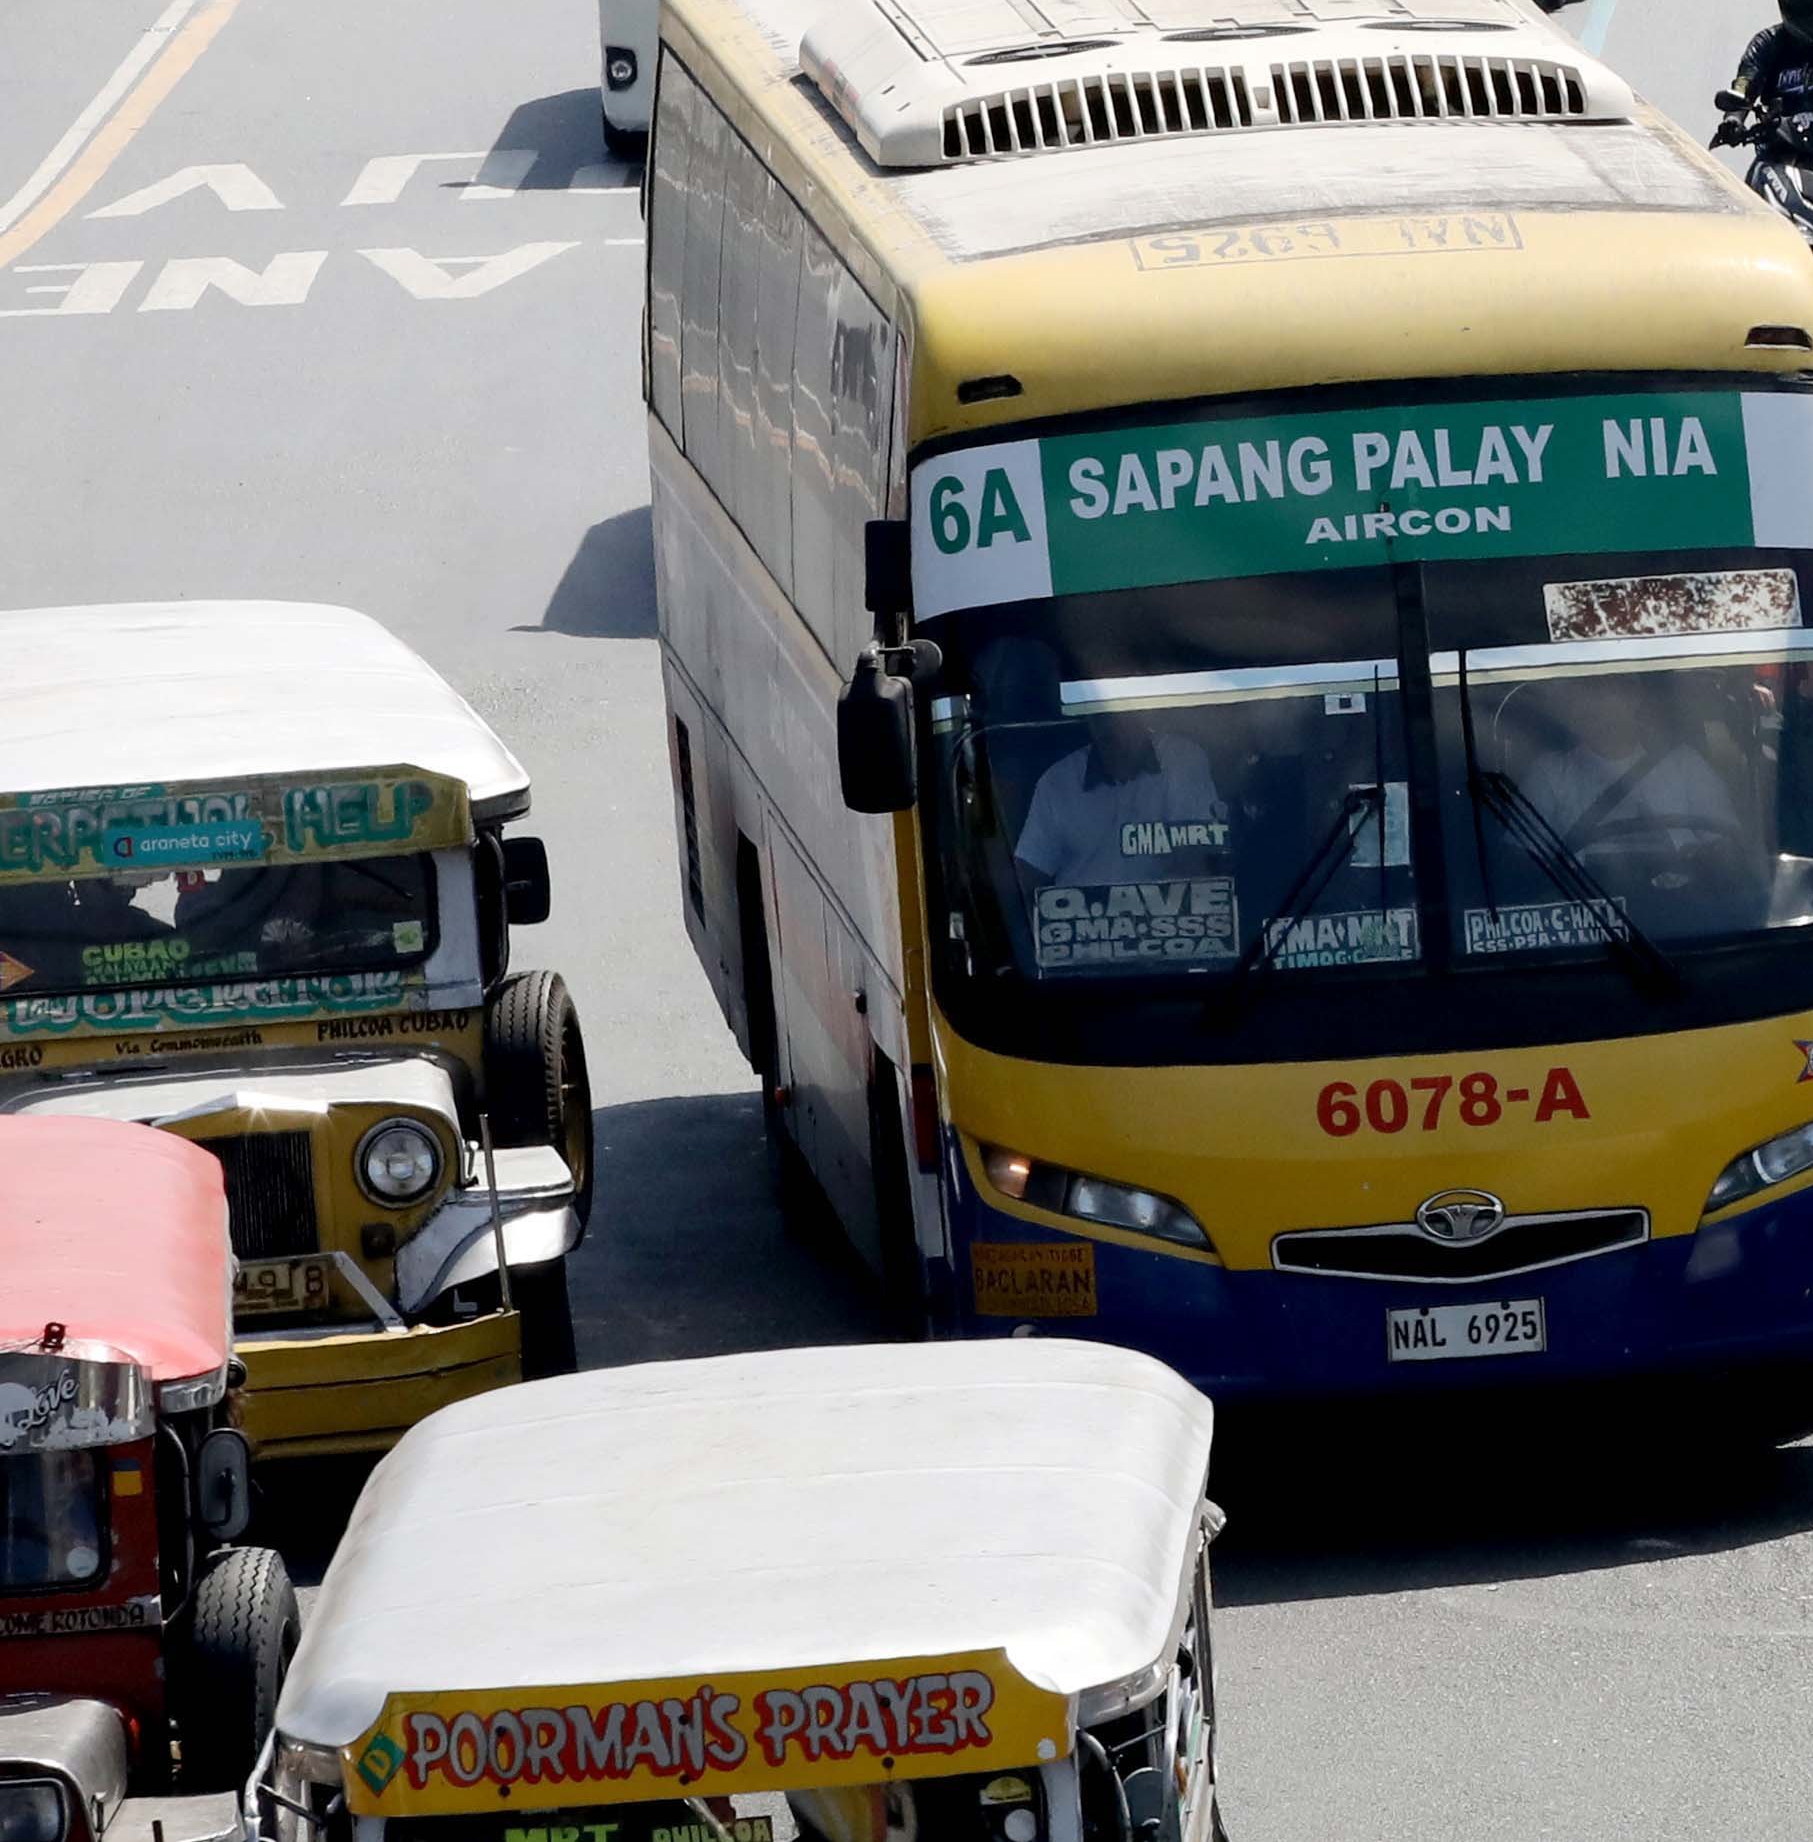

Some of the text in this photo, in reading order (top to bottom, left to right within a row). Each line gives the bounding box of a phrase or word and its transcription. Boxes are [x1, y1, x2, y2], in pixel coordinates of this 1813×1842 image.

[1068, 416, 1718, 520] SAPANG PALAY NIA
[927, 467, 1033, 556] 6A
[1305, 504, 1512, 545] AIRCON
[284, 780, 432, 850] HELP
[140, 829, 253, 852] araneta city
[1120, 821, 1231, 857] GMA MRT
[1039, 882, 1233, 919] Q.AVE
[82, 939, 191, 967] CUBAO
[1041, 937, 1230, 961] PHILCOA
[317, 1013, 469, 1041] PHILCOA CUBAO
[0, 1044, 43, 1068] GRO
[115, 1042, 140, 1055] Via
[1316, 1067, 1591, 1137] 6078-A
[975, 1267, 1092, 1295] BACLARAN
[1394, 1310, 1538, 1350] NAL 6925
[406, 1669, 996, 1789] POORMAN'S PRAYER
